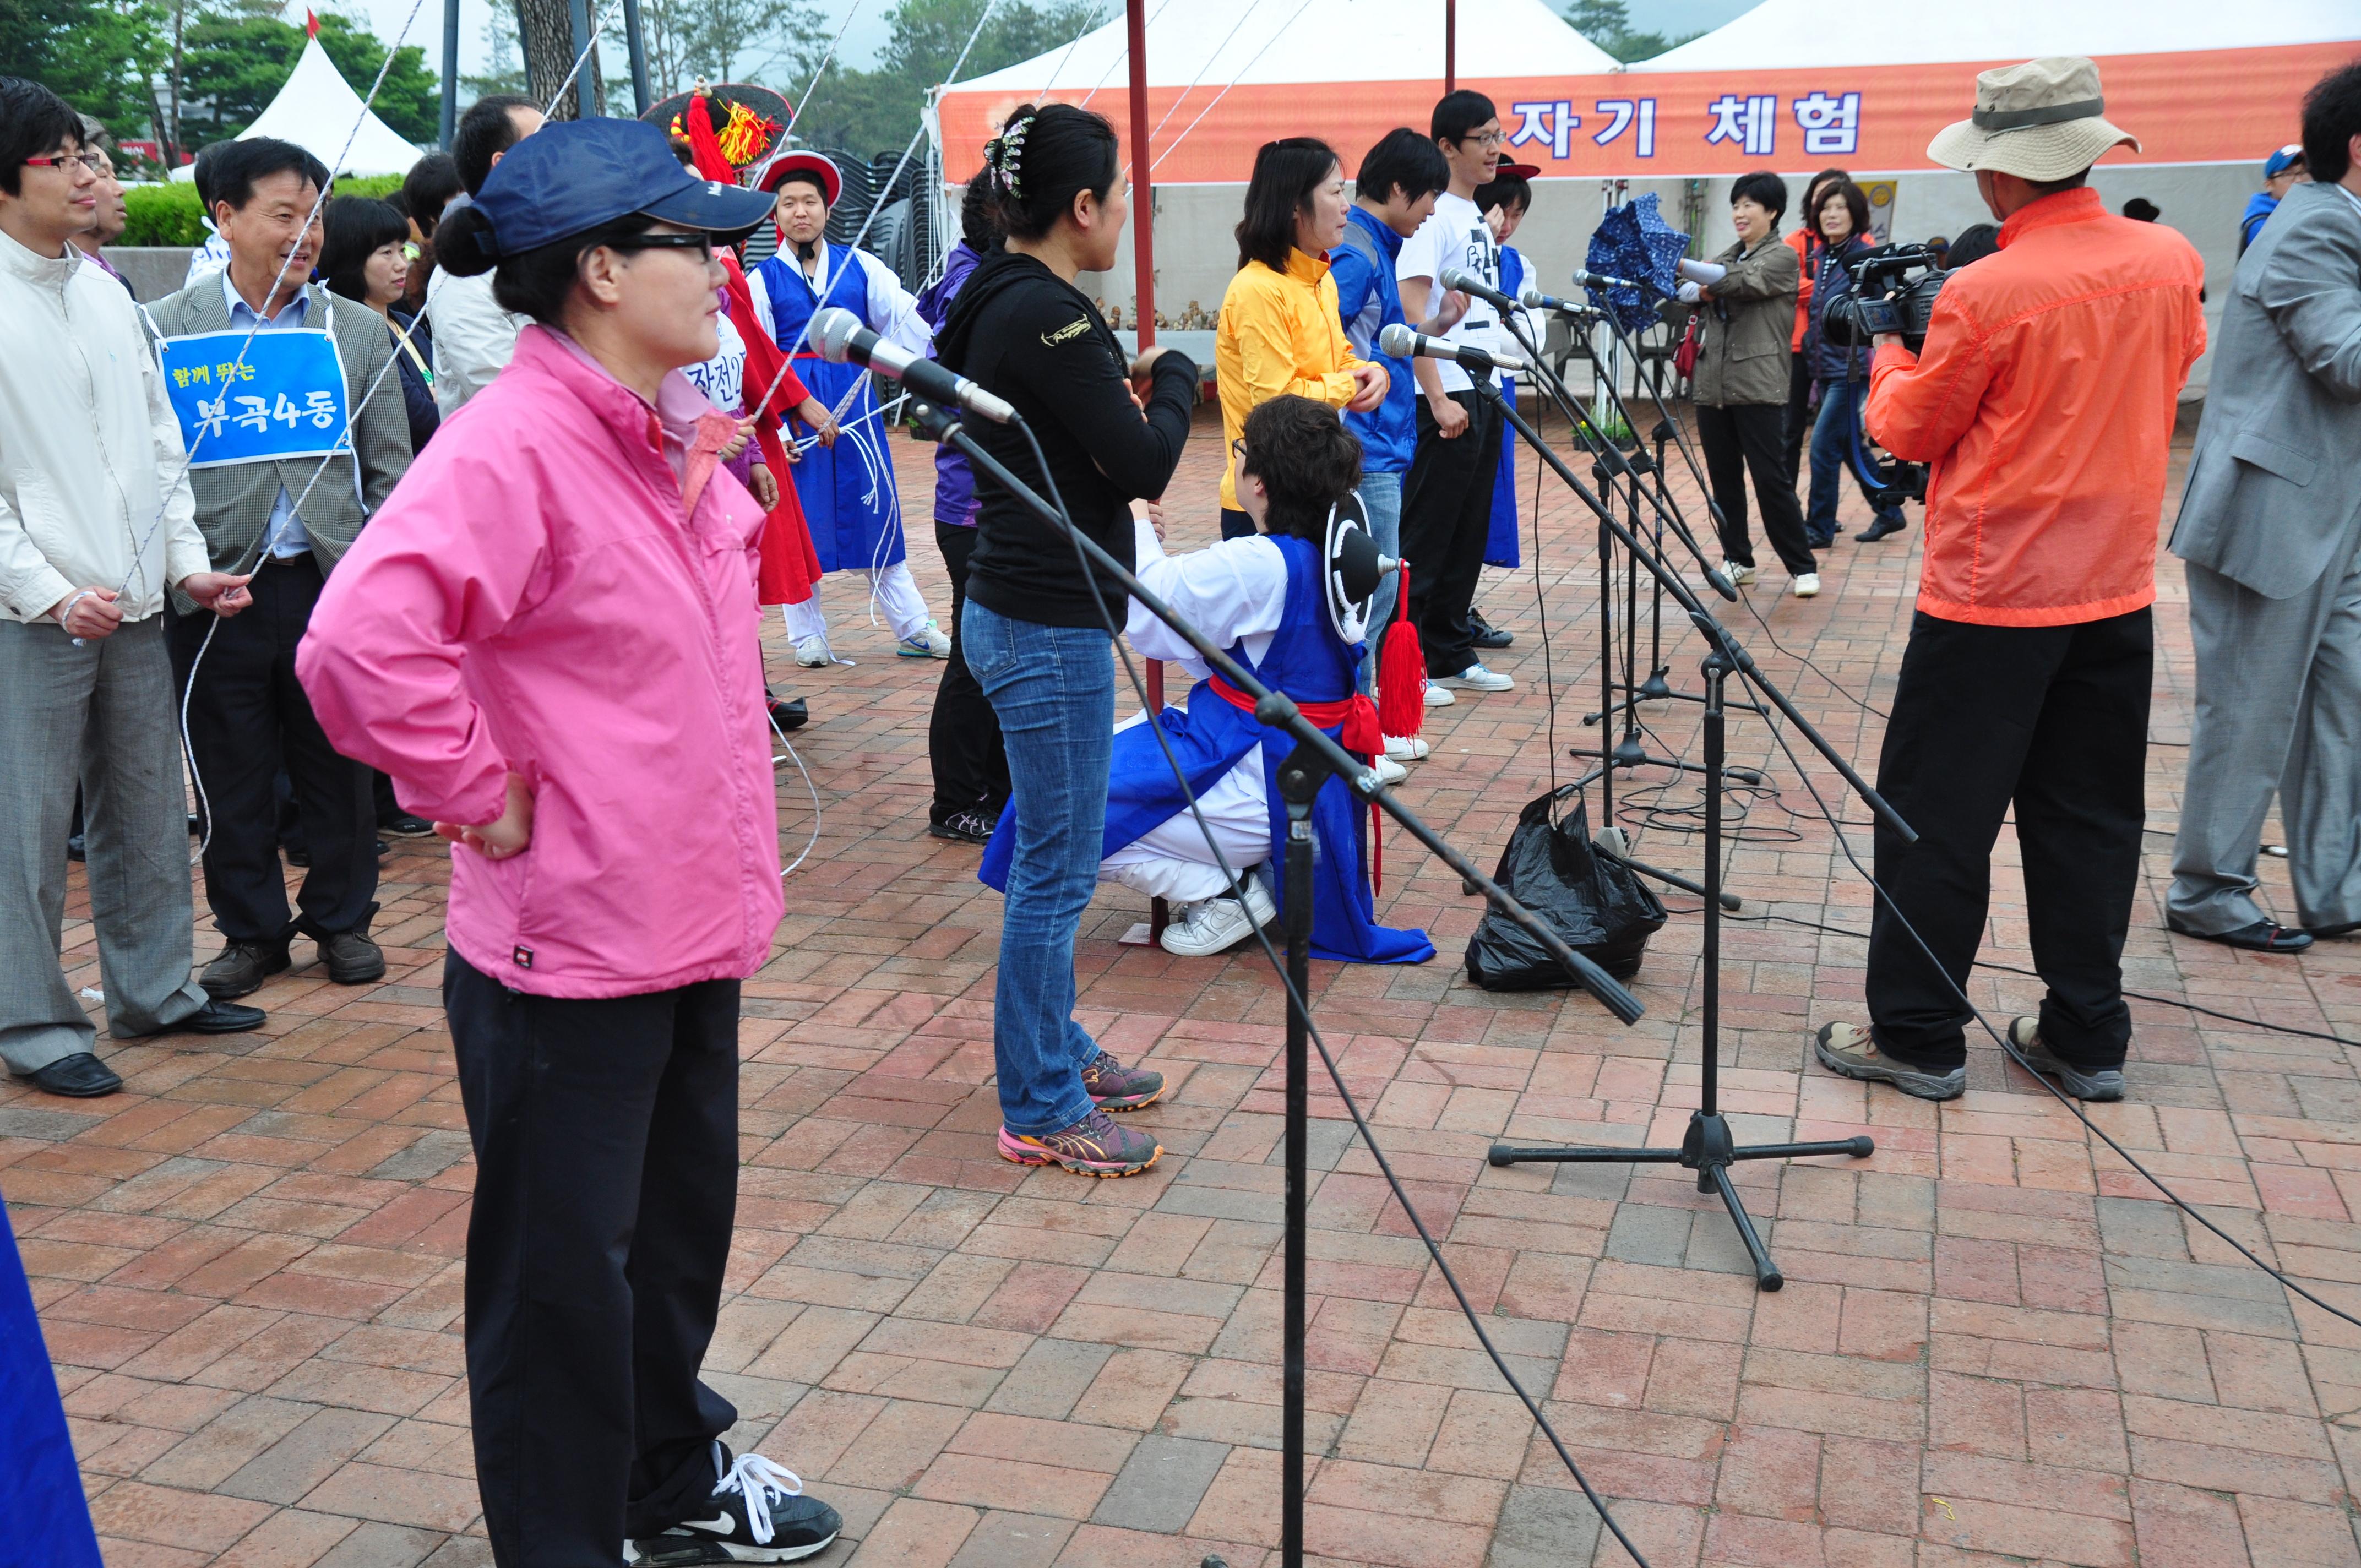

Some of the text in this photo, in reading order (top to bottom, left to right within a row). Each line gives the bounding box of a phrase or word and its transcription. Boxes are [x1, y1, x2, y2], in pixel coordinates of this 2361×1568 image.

[1510, 92, 1860, 159] 자기 체험
[172, 362, 255, 388] 함께 뛰는
[687, 351, 746, 402] 장전2
[193, 391, 337, 438] 부곡4동
